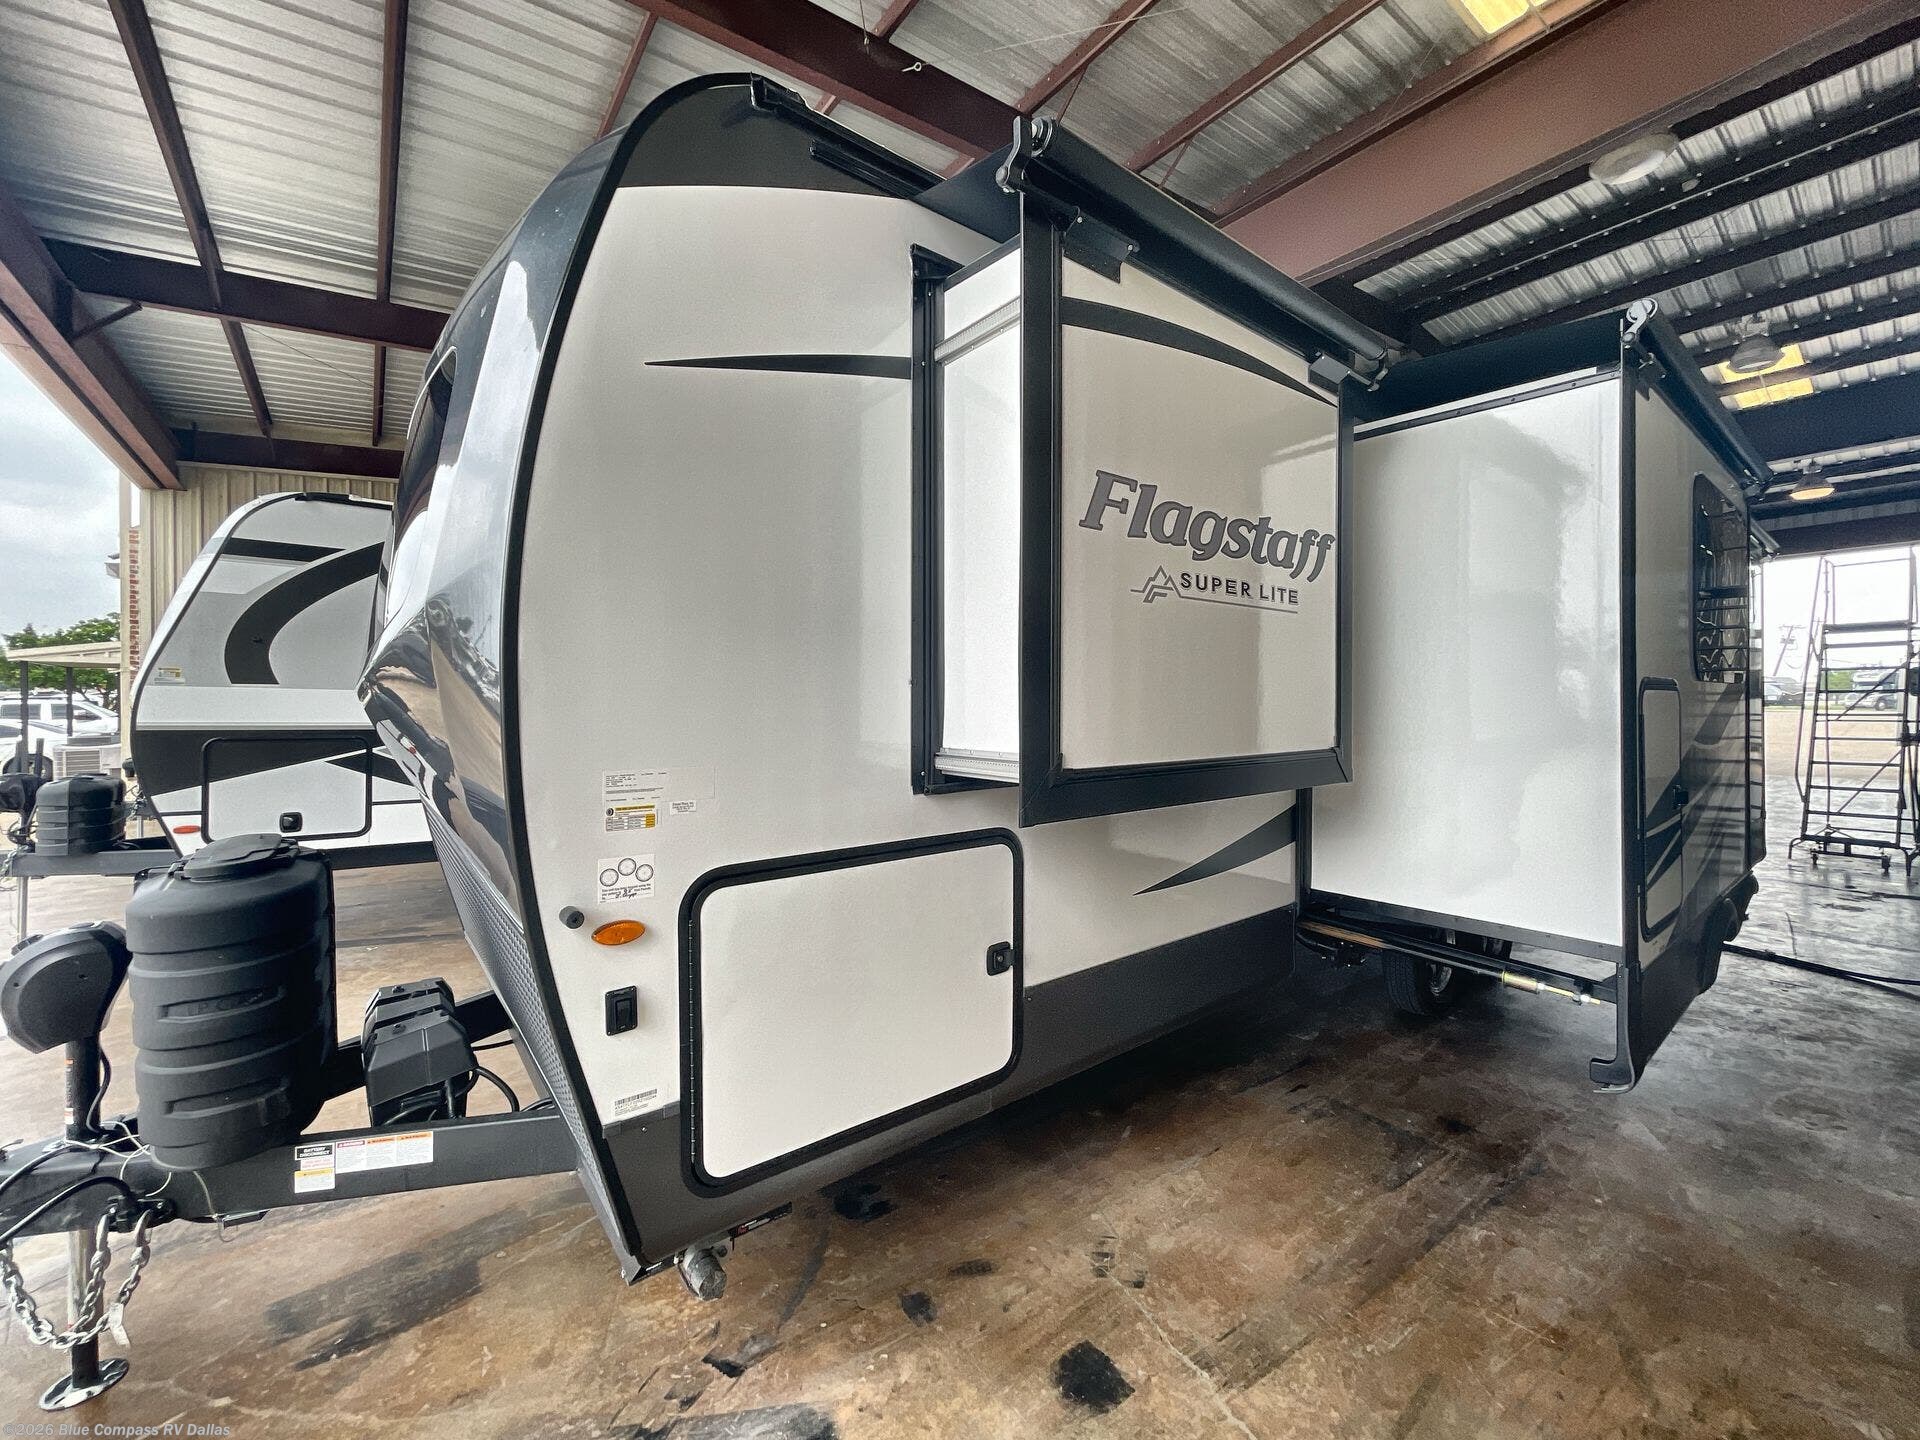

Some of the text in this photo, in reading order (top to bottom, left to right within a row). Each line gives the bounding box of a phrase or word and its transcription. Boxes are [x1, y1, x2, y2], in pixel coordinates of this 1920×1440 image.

[1078, 469, 1335, 583] Flagstaff
[1180, 572, 1299, 605] SUPER LITE
